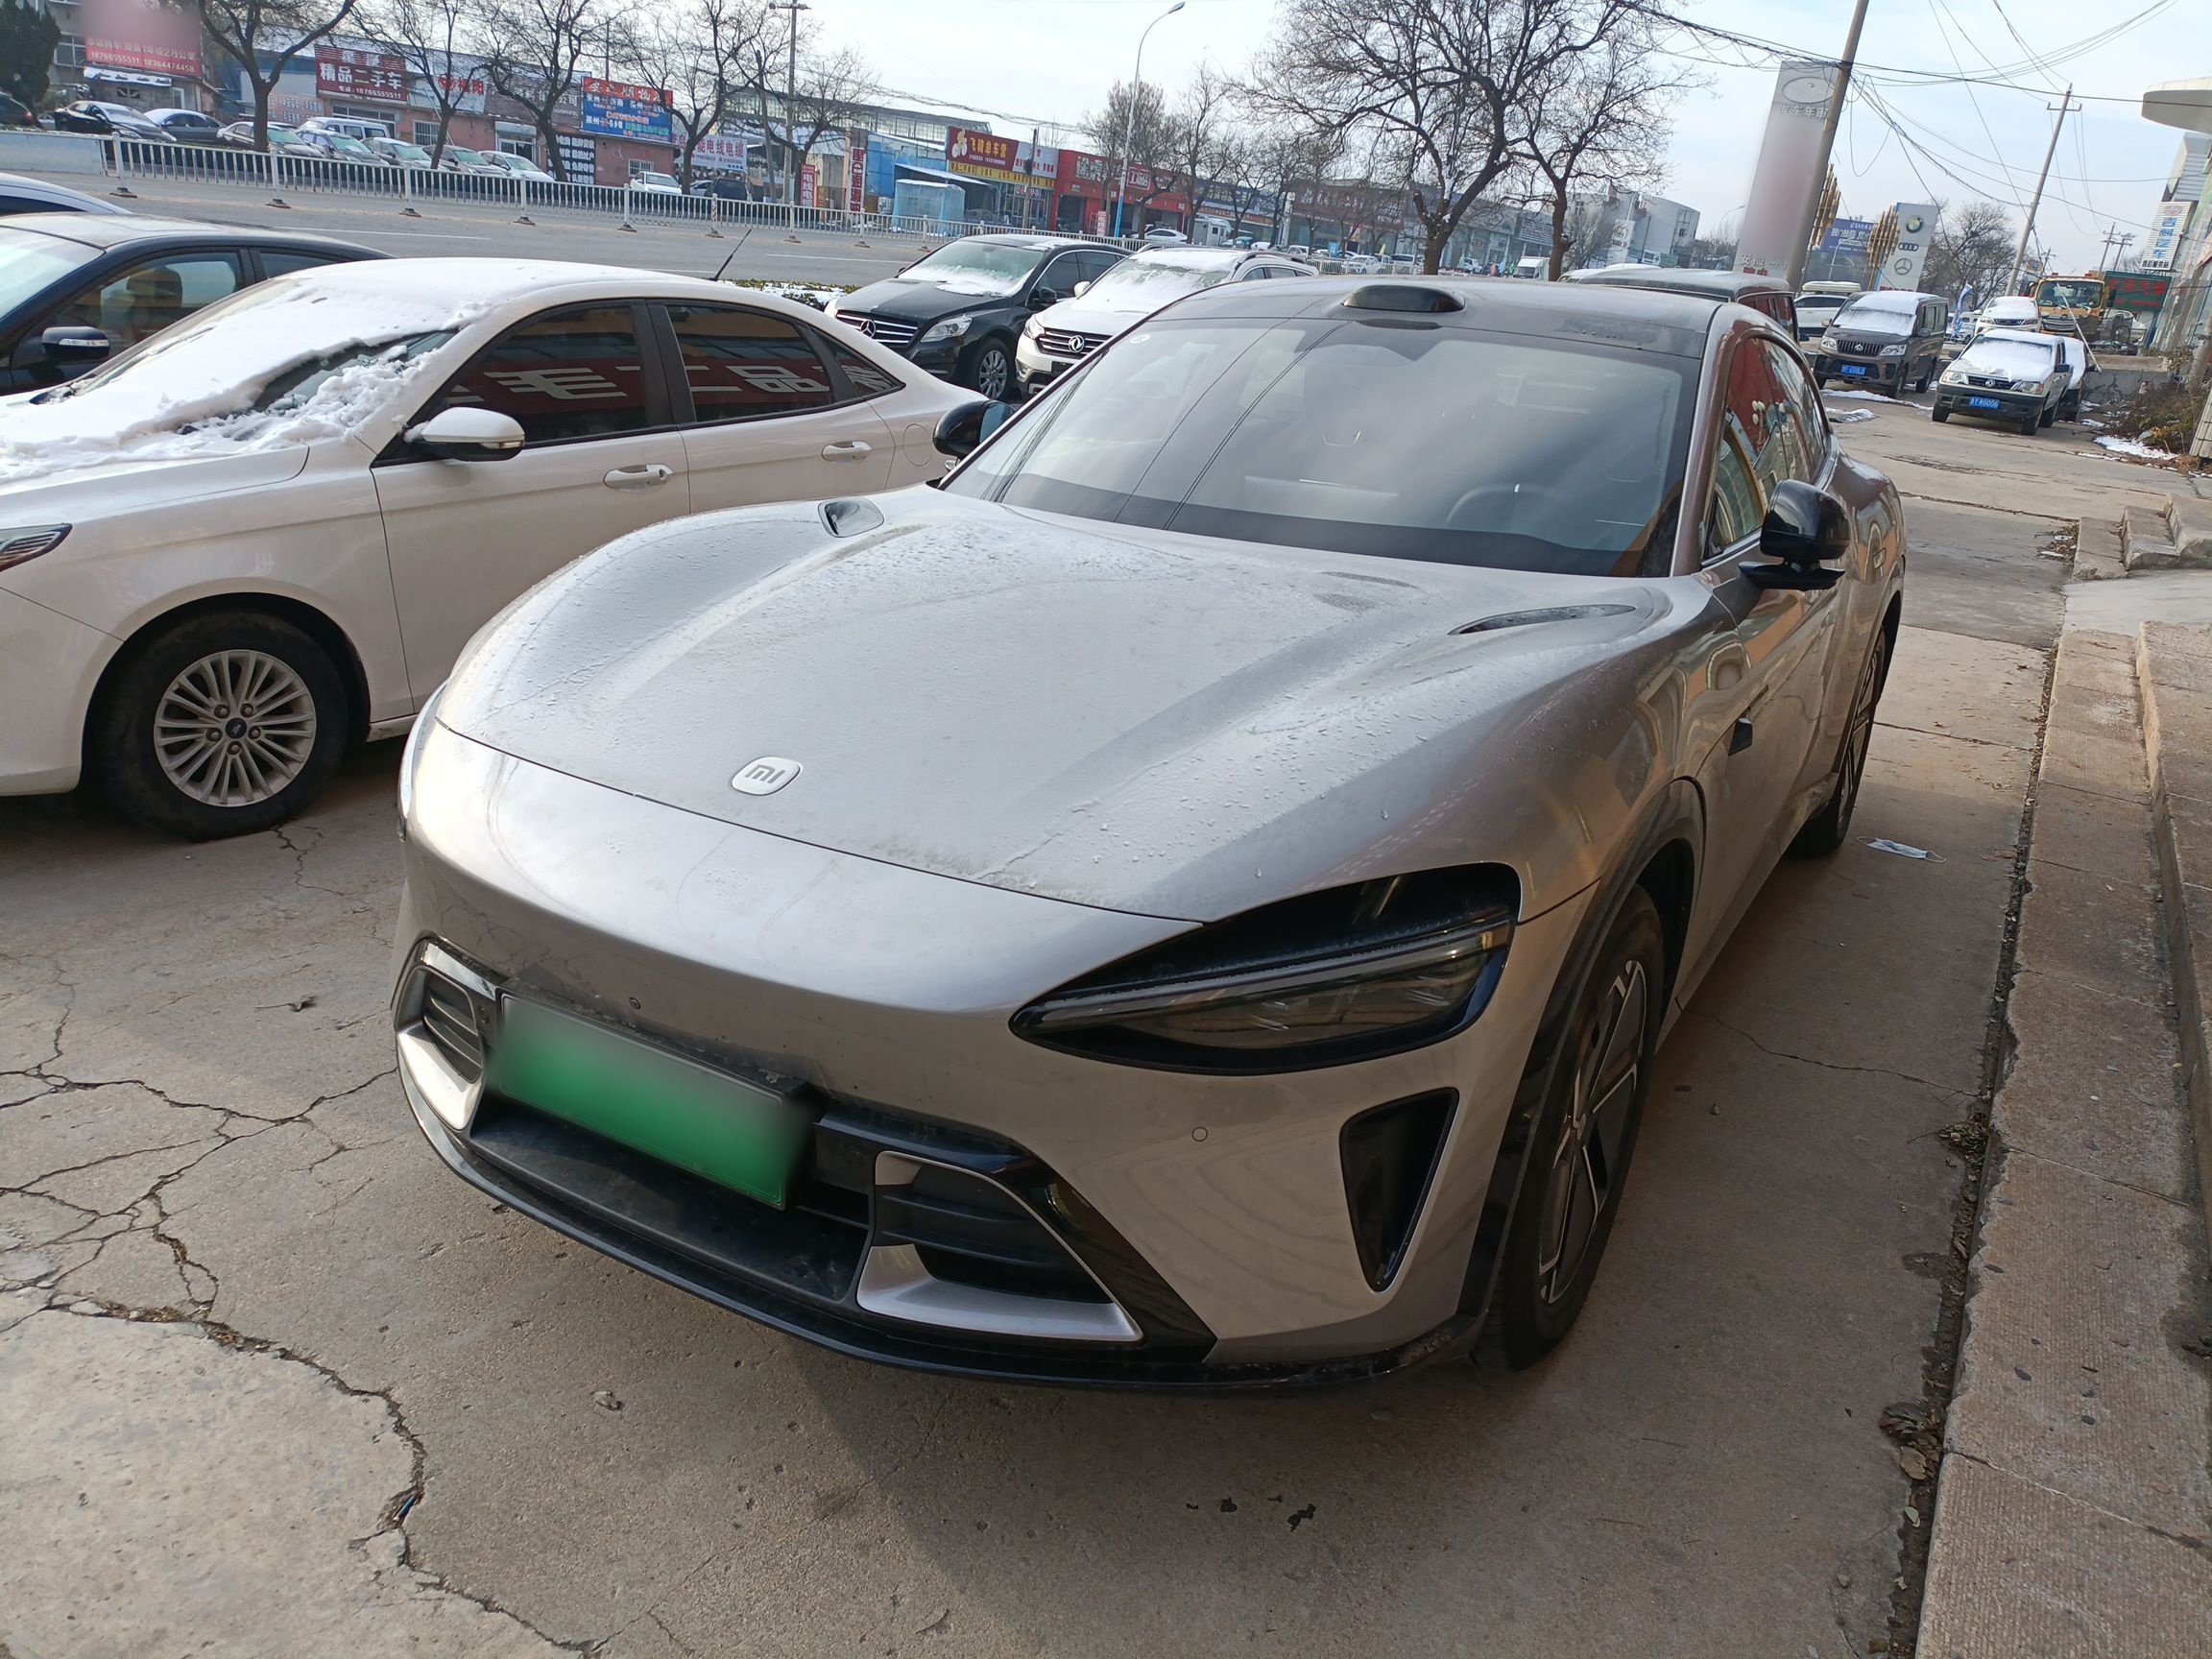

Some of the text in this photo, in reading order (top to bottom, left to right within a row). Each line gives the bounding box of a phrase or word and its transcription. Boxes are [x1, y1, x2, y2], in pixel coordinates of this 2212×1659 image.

[320, 62, 402, 90] 精品二手车
